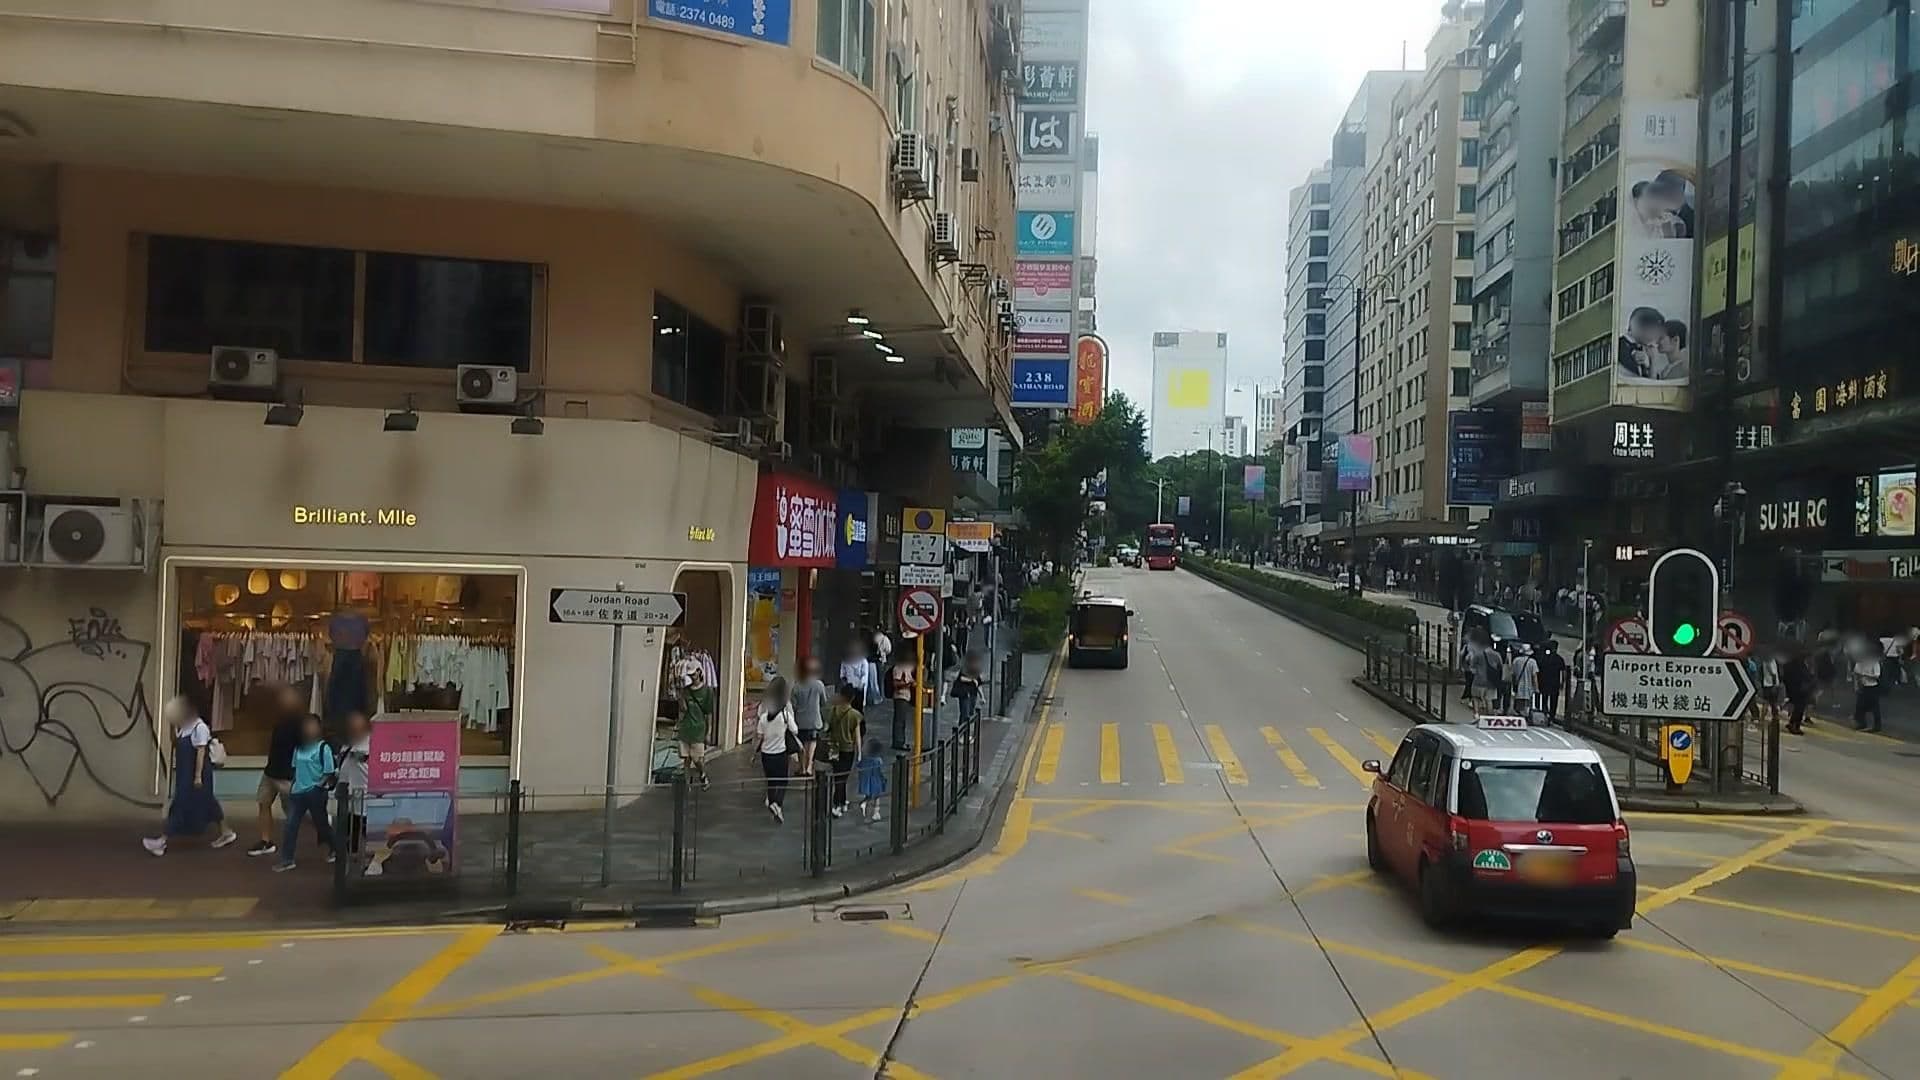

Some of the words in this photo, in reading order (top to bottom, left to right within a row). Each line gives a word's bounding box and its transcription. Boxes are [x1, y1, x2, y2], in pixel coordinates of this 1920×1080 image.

[680, 5, 706, 23] 2374
[709, 12, 735, 29] 0489
[1029, 115, 1063, 149] は
[1025, 372, 1052, 382] 238
[1614, 422, 1654, 447] 周生生
[294, 507, 372, 524] Brilliant.
[929, 535, 937, 547] 7
[928, 551, 936, 563] 7
[588, 594, 621, 605] Jordan
[624, 596, 650, 606] Road
[598, 608, 637, 620] 佐敦道
[1610, 659, 1660, 673] Airport
[1665, 661, 1722, 675] Express
[1639, 675, 1692, 688] Station
[1610, 691, 1711, 712] 機場快綫站
[1485, 718, 1522, 728] TAXI
